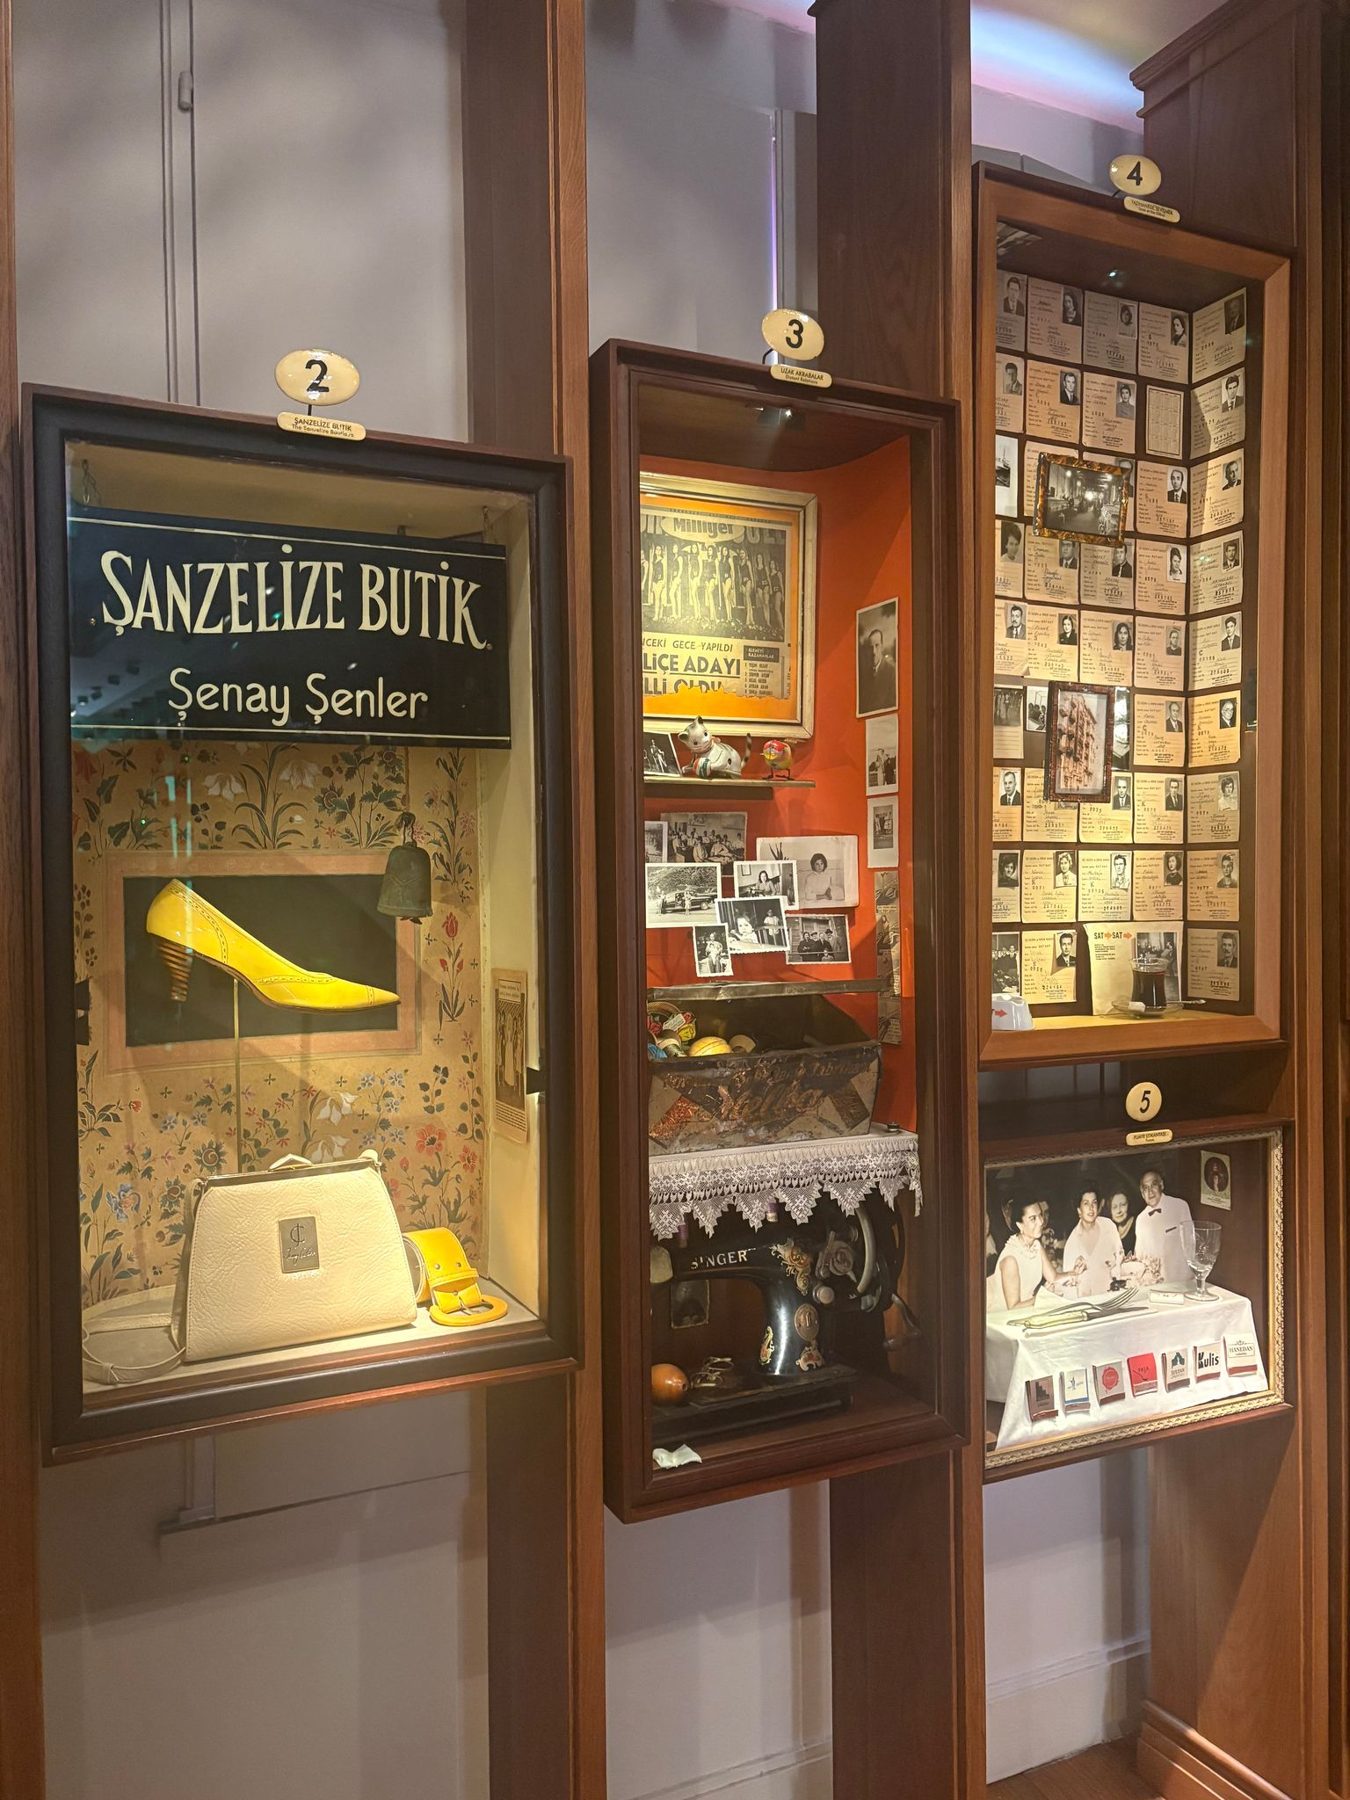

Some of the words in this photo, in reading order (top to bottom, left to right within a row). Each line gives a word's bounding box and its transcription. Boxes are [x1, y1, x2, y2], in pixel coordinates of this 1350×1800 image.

[1127, 160, 1143, 186] 4
[785, 319, 804, 349] 3
[305, 359, 330, 392] 2
[100, 543, 345, 637] ŞANZELİZE
[358, 561, 488, 650] BUTİK
[673, 640, 696, 650] GECE
[701, 642, 733, 653] YAPILDI
[683, 655, 741, 675] ADAYI
[168, 667, 290, 727] Şenay
[305, 673, 428, 724] Şenler
[1094, 932, 1104, 940] SAT
[1112, 931, 1123, 939] SAT
[1139, 1090, 1151, 1113] 5
[690, 1250, 748, 1270] SINGER
[1198, 1351, 1220, 1370] Kulis
